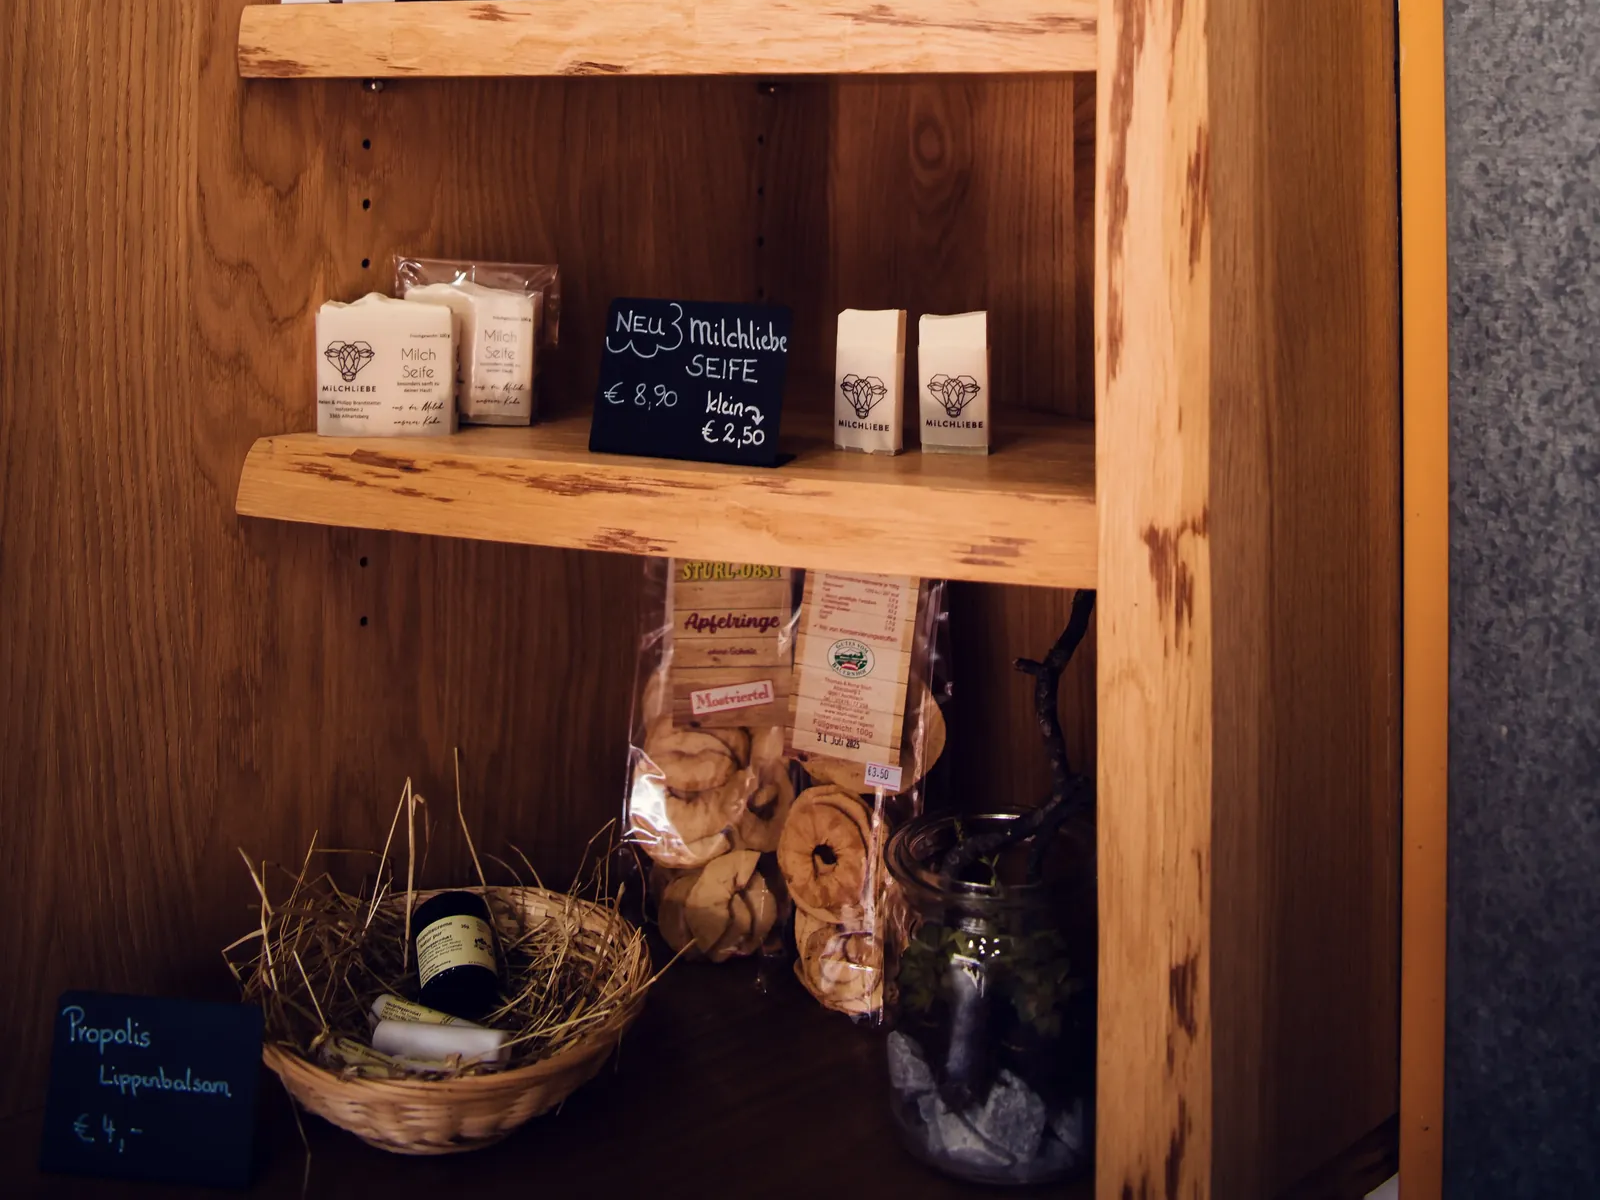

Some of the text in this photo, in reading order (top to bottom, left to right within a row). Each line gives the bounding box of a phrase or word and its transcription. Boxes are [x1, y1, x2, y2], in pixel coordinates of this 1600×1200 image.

[484, 329, 517, 342] Milch
[616, 310, 666, 336] NEU
[402, 348, 436, 360] Milch
[485, 345, 515, 360] Seife
[402, 365, 434, 378] Seife
[685, 354, 758, 384] SEIFE
[604, 381, 678, 411] € 8,90
[706, 390, 744, 417] klein
[701, 420, 765, 449] € 2,50
[684, 613, 780, 634] Apfelringe
[696, 684, 770, 709] Mostviertel
[856, 728, 873, 739] 100g
[867, 765, 889, 780] €3.50
[62, 1005, 151, 1055] Propolis
[100, 1064, 232, 1097] Lippenbalsam
[73, 1113, 95, 1143] €
